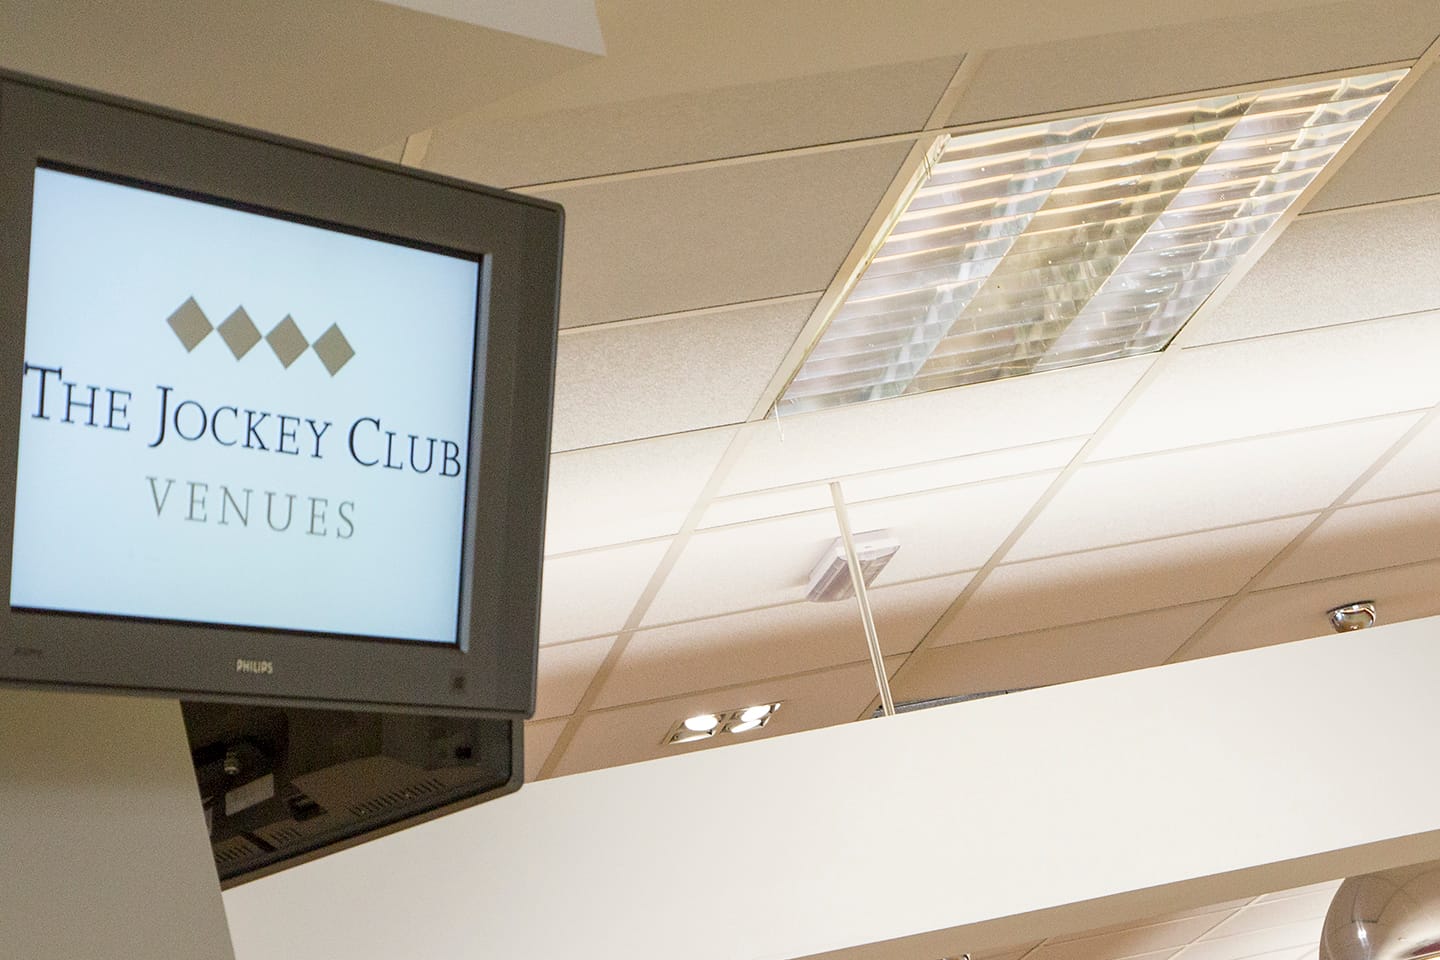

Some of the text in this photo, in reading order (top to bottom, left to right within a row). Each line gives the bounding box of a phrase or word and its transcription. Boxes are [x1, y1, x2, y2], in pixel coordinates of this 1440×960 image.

[24, 362, 462, 478] THE JOCKEY CLUB
[145, 476, 356, 540] VENUES
[236, 659, 274, 674] PHILIPS
